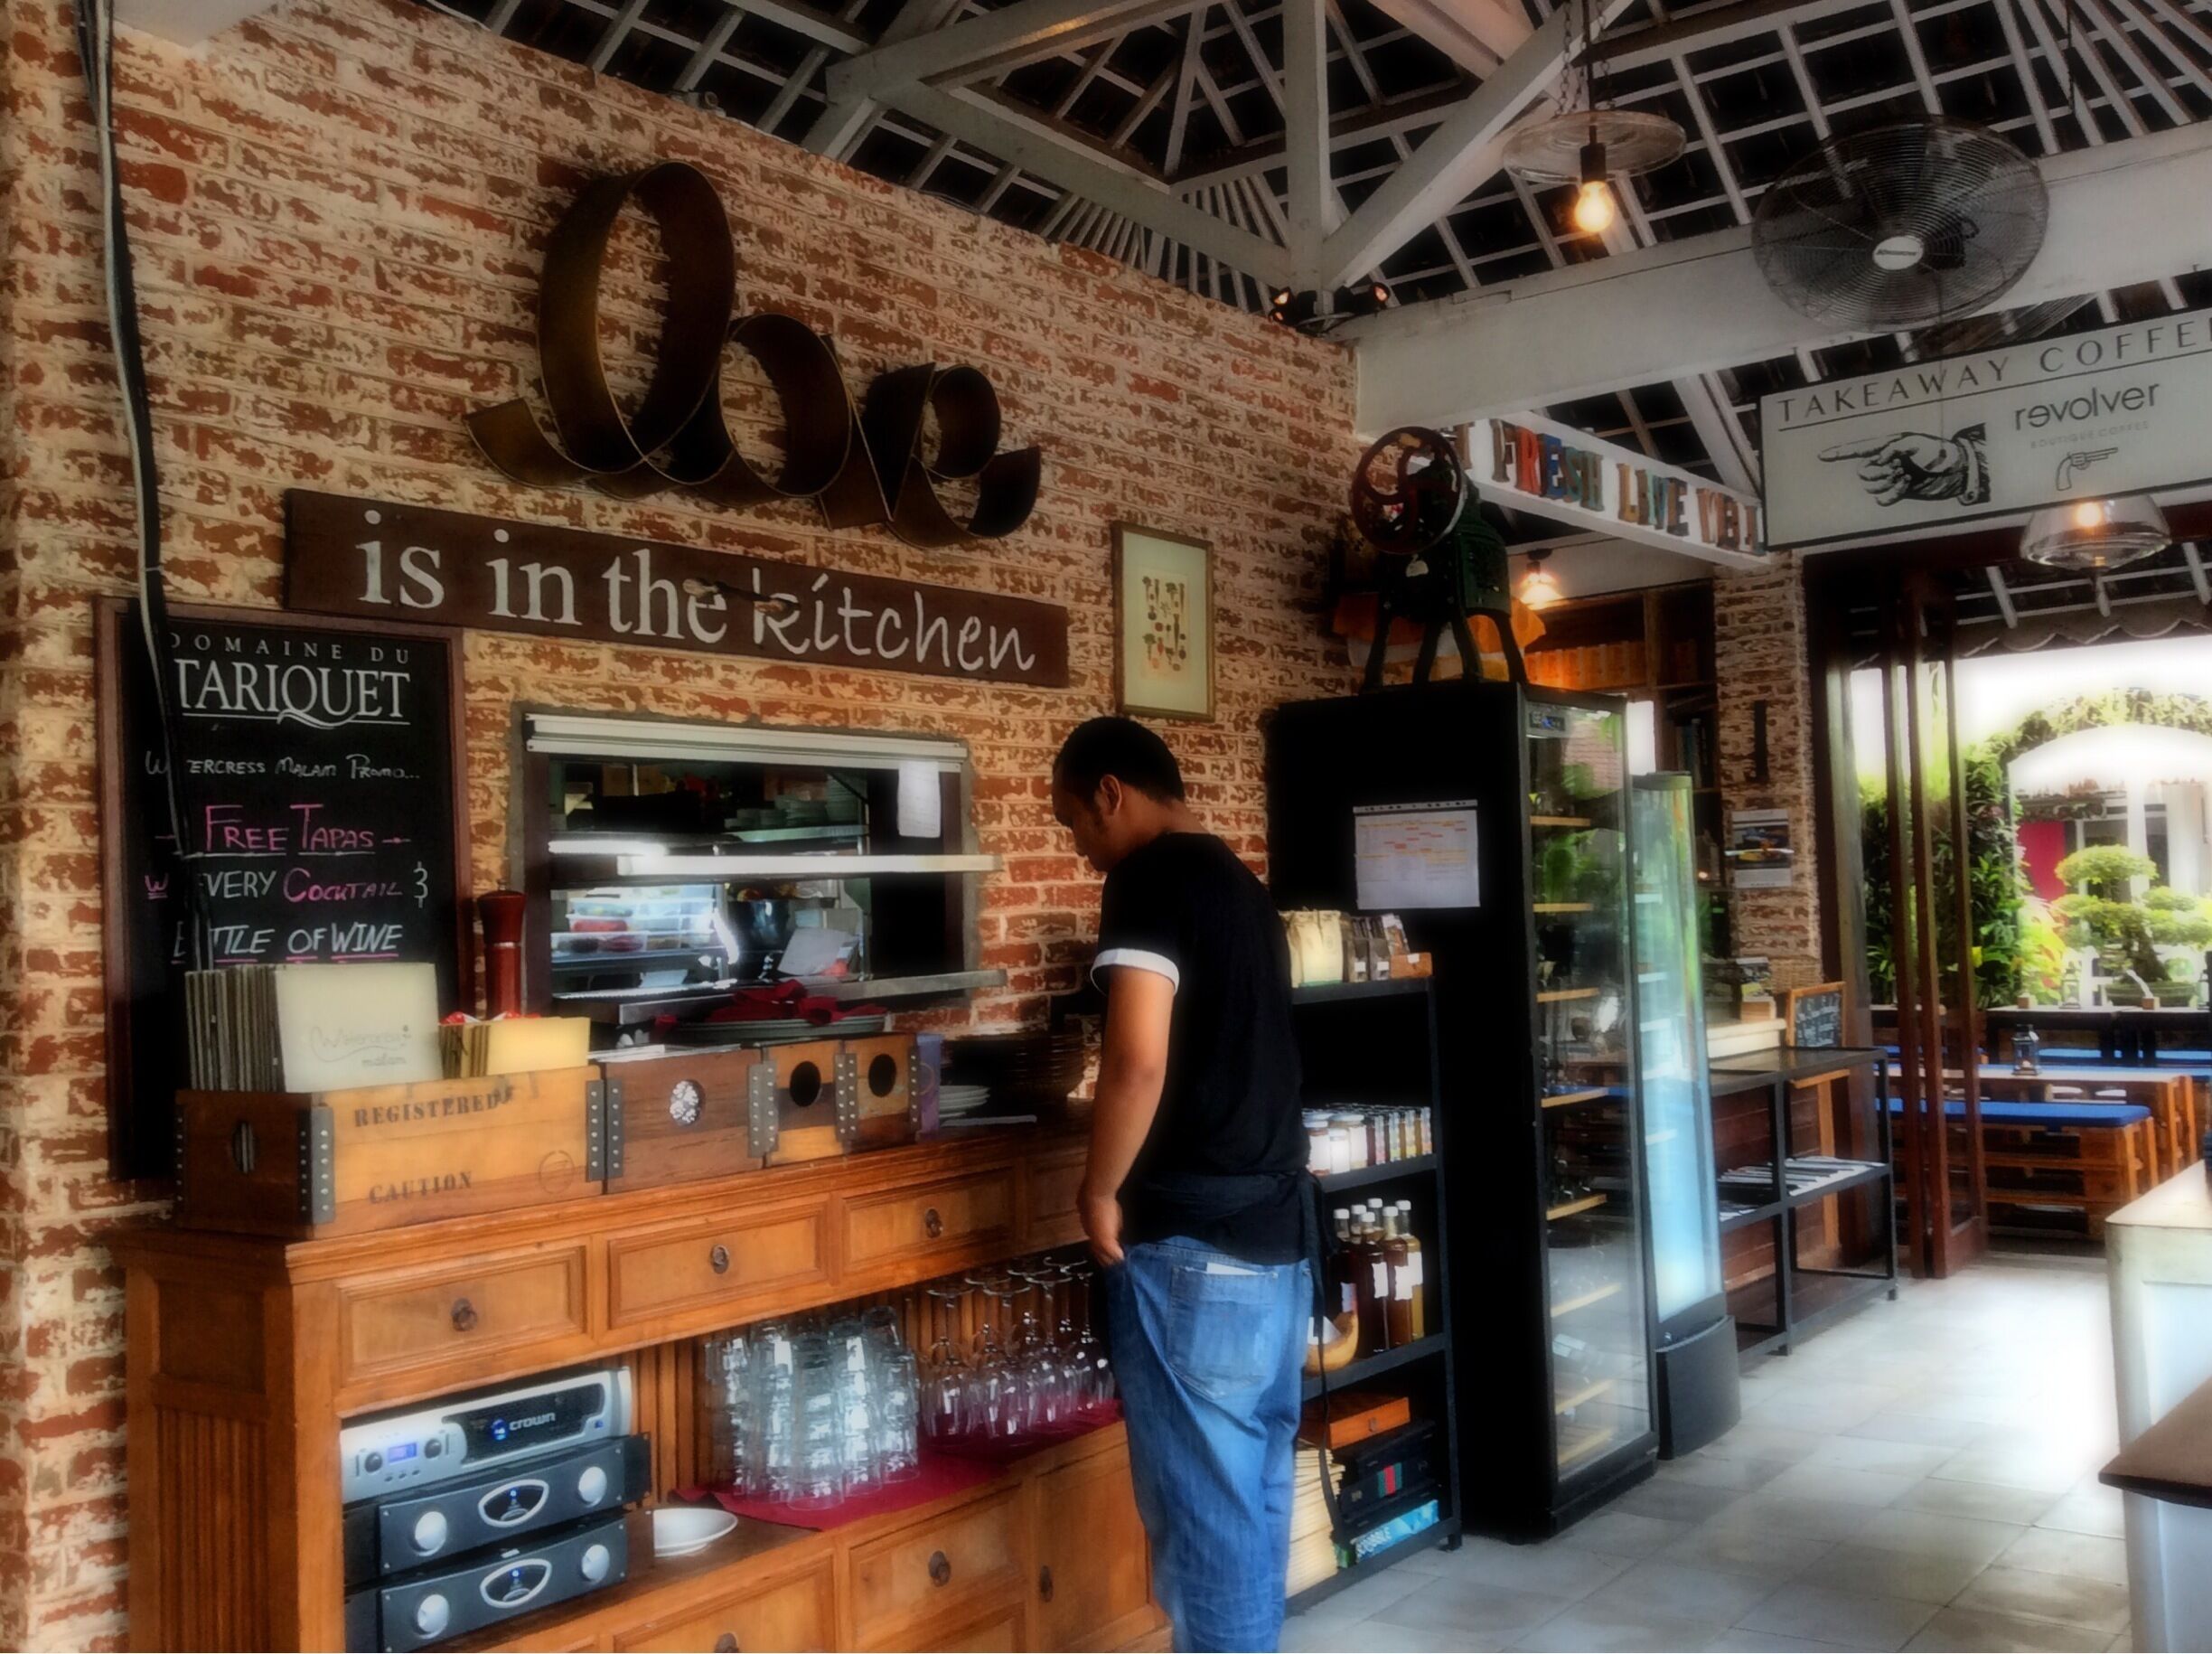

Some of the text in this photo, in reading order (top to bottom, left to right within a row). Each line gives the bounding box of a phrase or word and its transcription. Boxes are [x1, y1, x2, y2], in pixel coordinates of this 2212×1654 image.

[1777, 317, 2212, 422] TAKEAWAY COFFE
[2014, 383, 2160, 431] revolver
[1489, 418, 1605, 512] FRESH
[1616, 463, 1689, 537] LIVE
[356, 509, 1036, 672] is in the kitchen
[370, 638, 409, 664] DU
[173, 658, 411, 723] TARIQUET
[145, 750, 266, 775] WERCRESS
[205, 803, 374, 851] FREE TAPAS
[199, 869, 277, 898] VERY
[287, 927, 326, 954] OF
[329, 922, 403, 953] WINE
[353, 1090, 502, 1127] REGISTERED
[368, 1170, 473, 1204] CAUTION
[509, 1412, 557, 1432] crown
